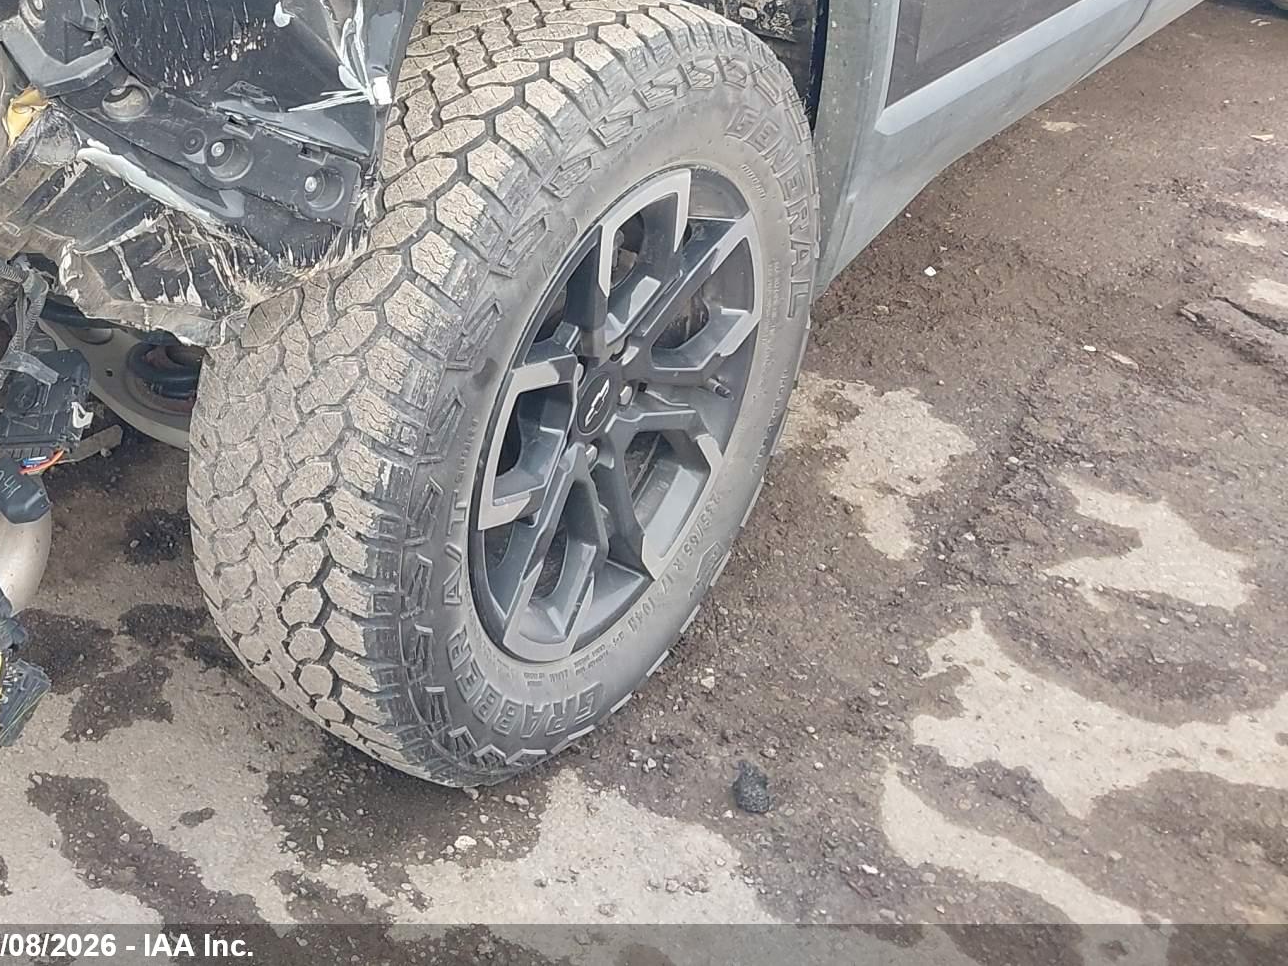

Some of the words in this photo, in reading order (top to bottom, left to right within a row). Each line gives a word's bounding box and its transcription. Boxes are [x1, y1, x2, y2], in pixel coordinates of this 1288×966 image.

[724, 104, 812, 319] GENERAL
[442, 489, 468, 606] A/T
[445, 624, 604, 739] GRABBER
